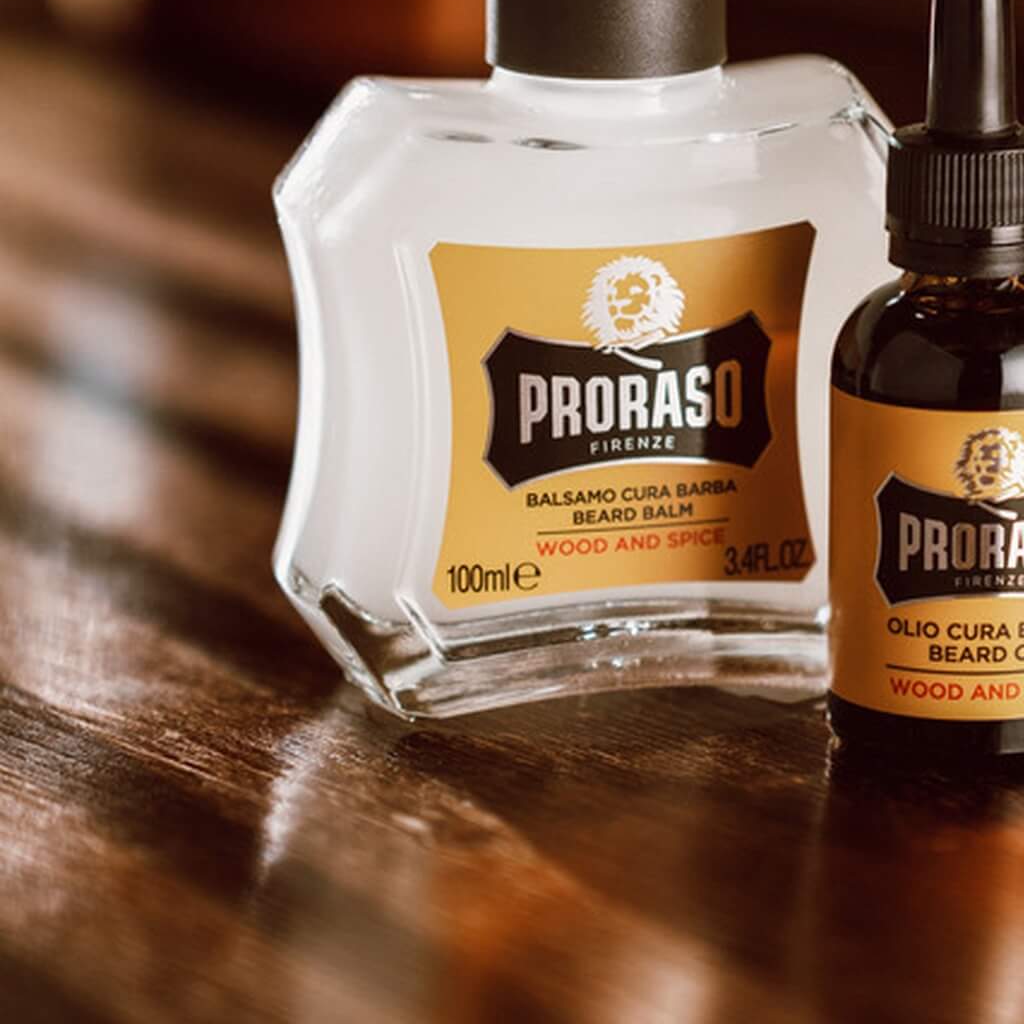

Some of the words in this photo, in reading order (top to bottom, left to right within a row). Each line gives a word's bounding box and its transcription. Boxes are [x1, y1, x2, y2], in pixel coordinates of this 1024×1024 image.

[519, 359, 742, 444] PRORASO
[589, 435, 676, 455] FIRENZE
[526, 488, 617, 508] BALSAMO
[621, 484, 671, 501] CURA
[676, 479, 737, 498] BARBA
[573, 509, 637, 526] BEARD
[642, 503, 693, 520] BALM
[536, 539, 608, 557] WOOD
[616, 534, 661, 551] AND
[667, 527, 726, 547] SPICE
[886, 616, 940, 639] OLIO
[946, 622, 1012, 641] CURA
[928, 645, 1008, 664] BEARD
[889, 676, 964, 701] WOOD
[970, 681, 1021, 701] AND
